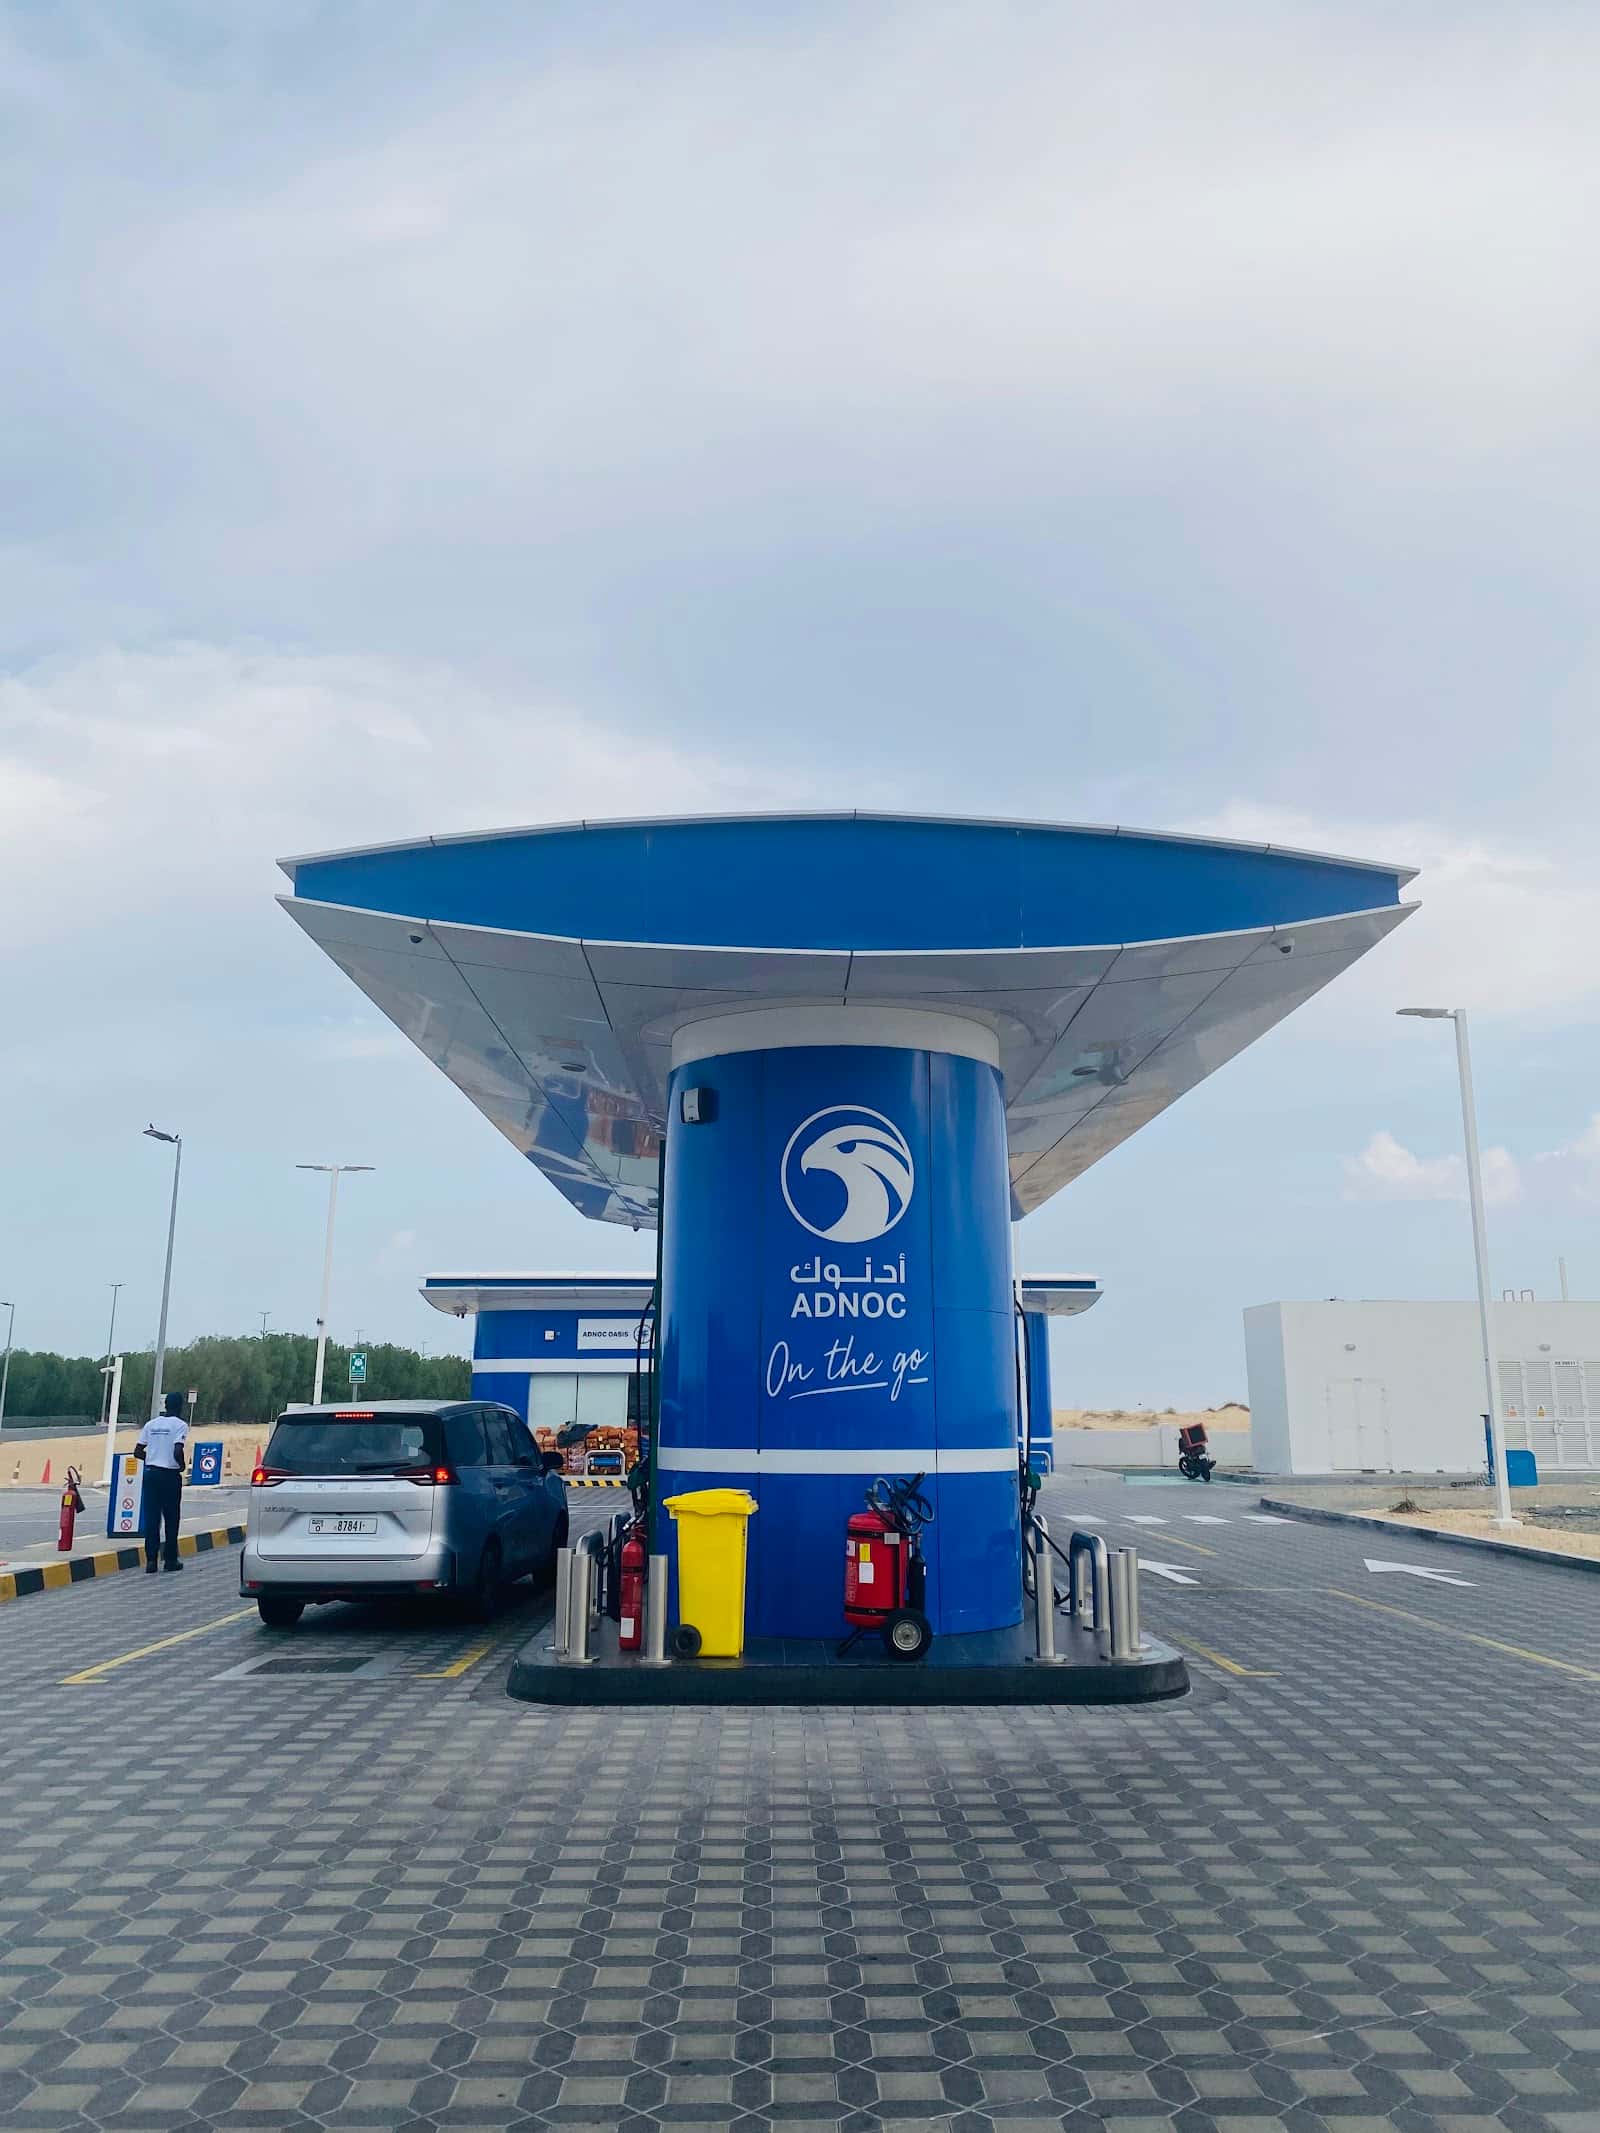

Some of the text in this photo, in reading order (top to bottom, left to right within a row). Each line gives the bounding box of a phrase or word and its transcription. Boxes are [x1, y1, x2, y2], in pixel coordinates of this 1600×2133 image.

[790, 1252, 906, 1290] أدنوك
[790, 1292, 907, 1318] ADNOC
[766, 1335, 929, 1401] On the go
[337, 1520, 362, 1532] 87841
